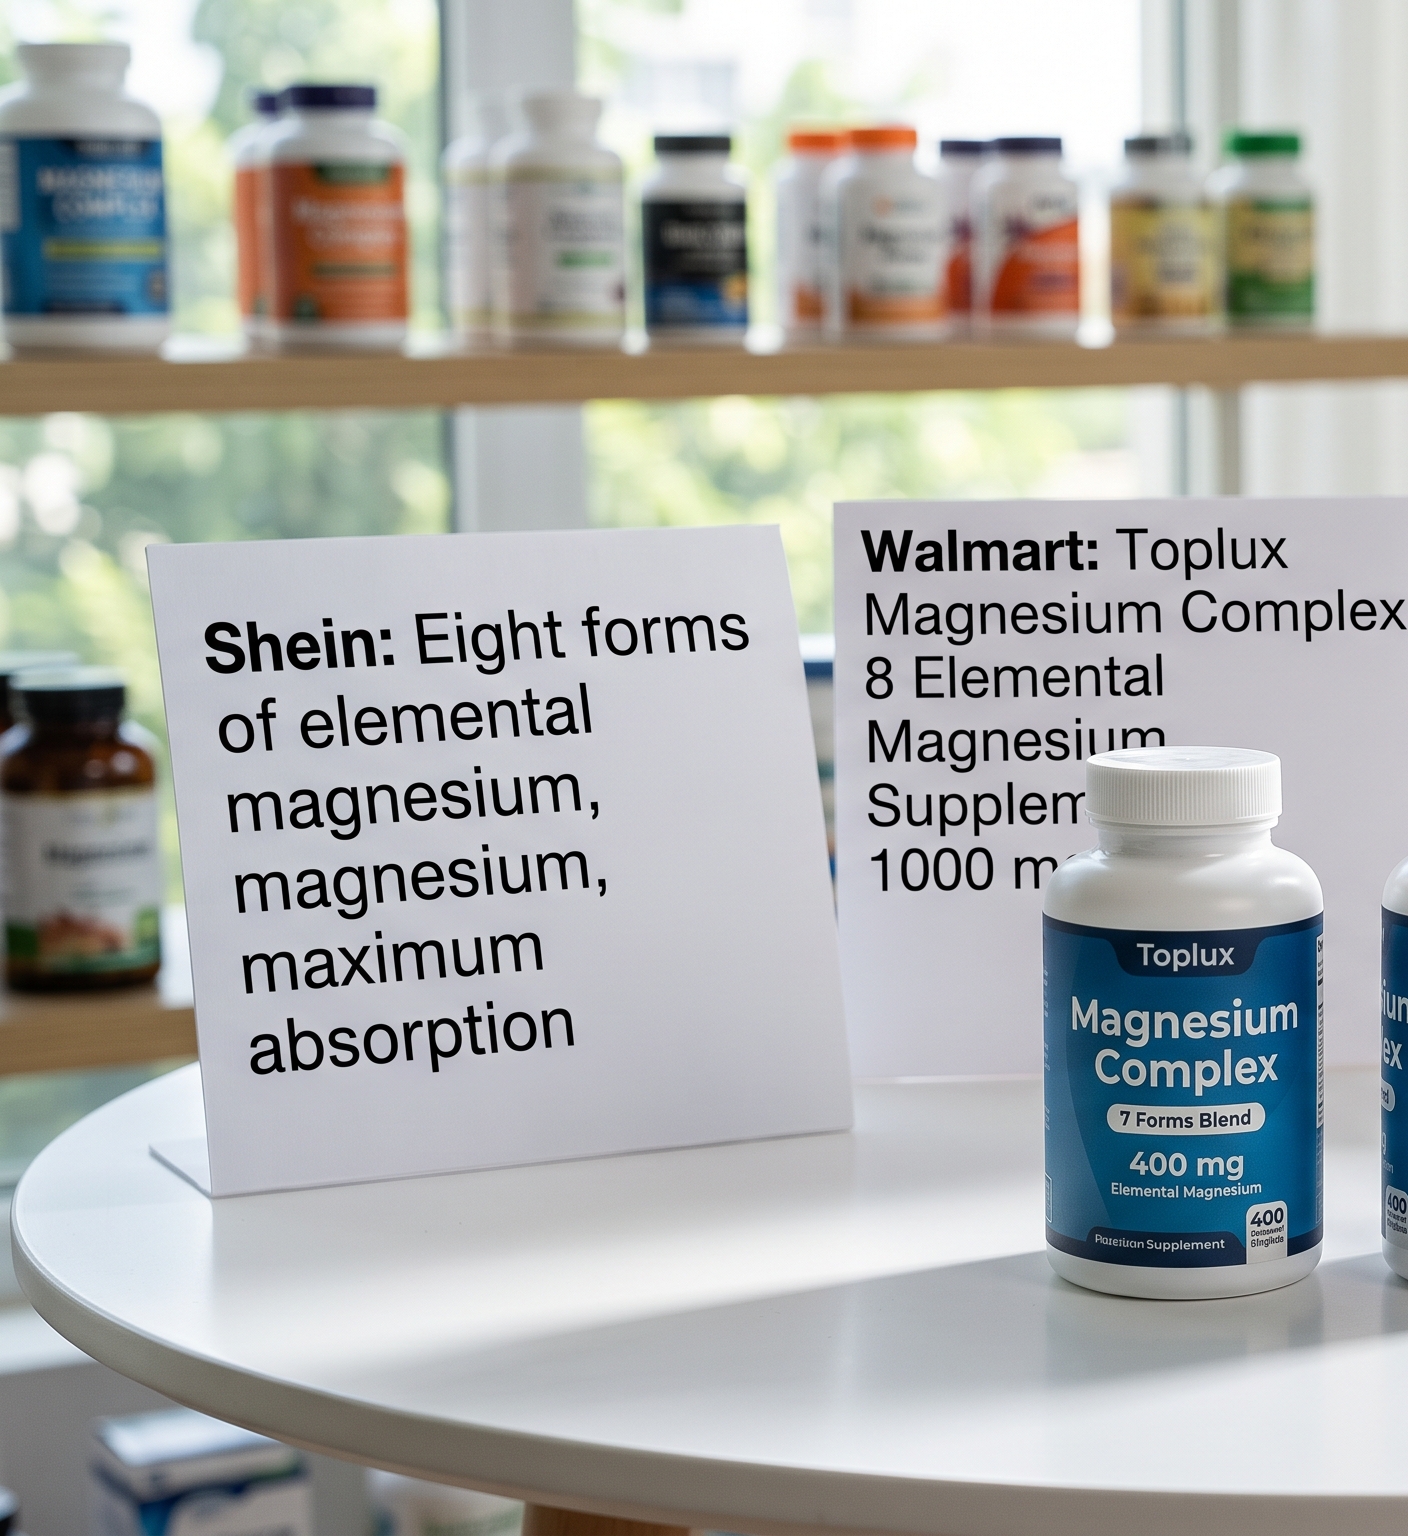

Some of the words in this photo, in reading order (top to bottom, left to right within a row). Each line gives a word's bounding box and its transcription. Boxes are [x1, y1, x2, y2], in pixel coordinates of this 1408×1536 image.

[861, 530, 1097, 572] Walmart:
[1116, 527, 1288, 580] Toplux
[205, 618, 394, 674] Shein:
[415, 610, 566, 675] Eight
[582, 606, 749, 656] forms
[866, 592, 1161, 645] Magnesium
[1182, 589, 1406, 642] Complex
[866, 657, 893, 699] 8
[915, 654, 1162, 698] Elemental
[219, 697, 276, 753] of
[301, 683, 591, 748] elemental
[228, 766, 598, 840] magnesium,
[235, 844, 606, 919] magnesium,
[871, 847, 993, 891] 1000
[1015, 854, 1076, 889] m
[242, 931, 543, 994] maximum
[1137, 943, 1235, 972] Toplux
[250, 1001, 574, 1075] absorption
[1071, 996, 1298, 1048] Magnesium
[1094, 1049, 1278, 1097] Complex
[1120, 1110, 1130, 1126] 7
[1136, 1112, 1194, 1128] Forms
[1200, 1109, 1251, 1128] Blend
[1111, 1182, 1179, 1198] Elemental
[1183, 1182, 1262, 1200] Magnesium
[1129, 1151, 1187, 1177] 400
[1197, 1155, 1244, 1181] mg
[1250, 1207, 1284, 1227] 400
[1146, 1239, 1225, 1252] Supplement
